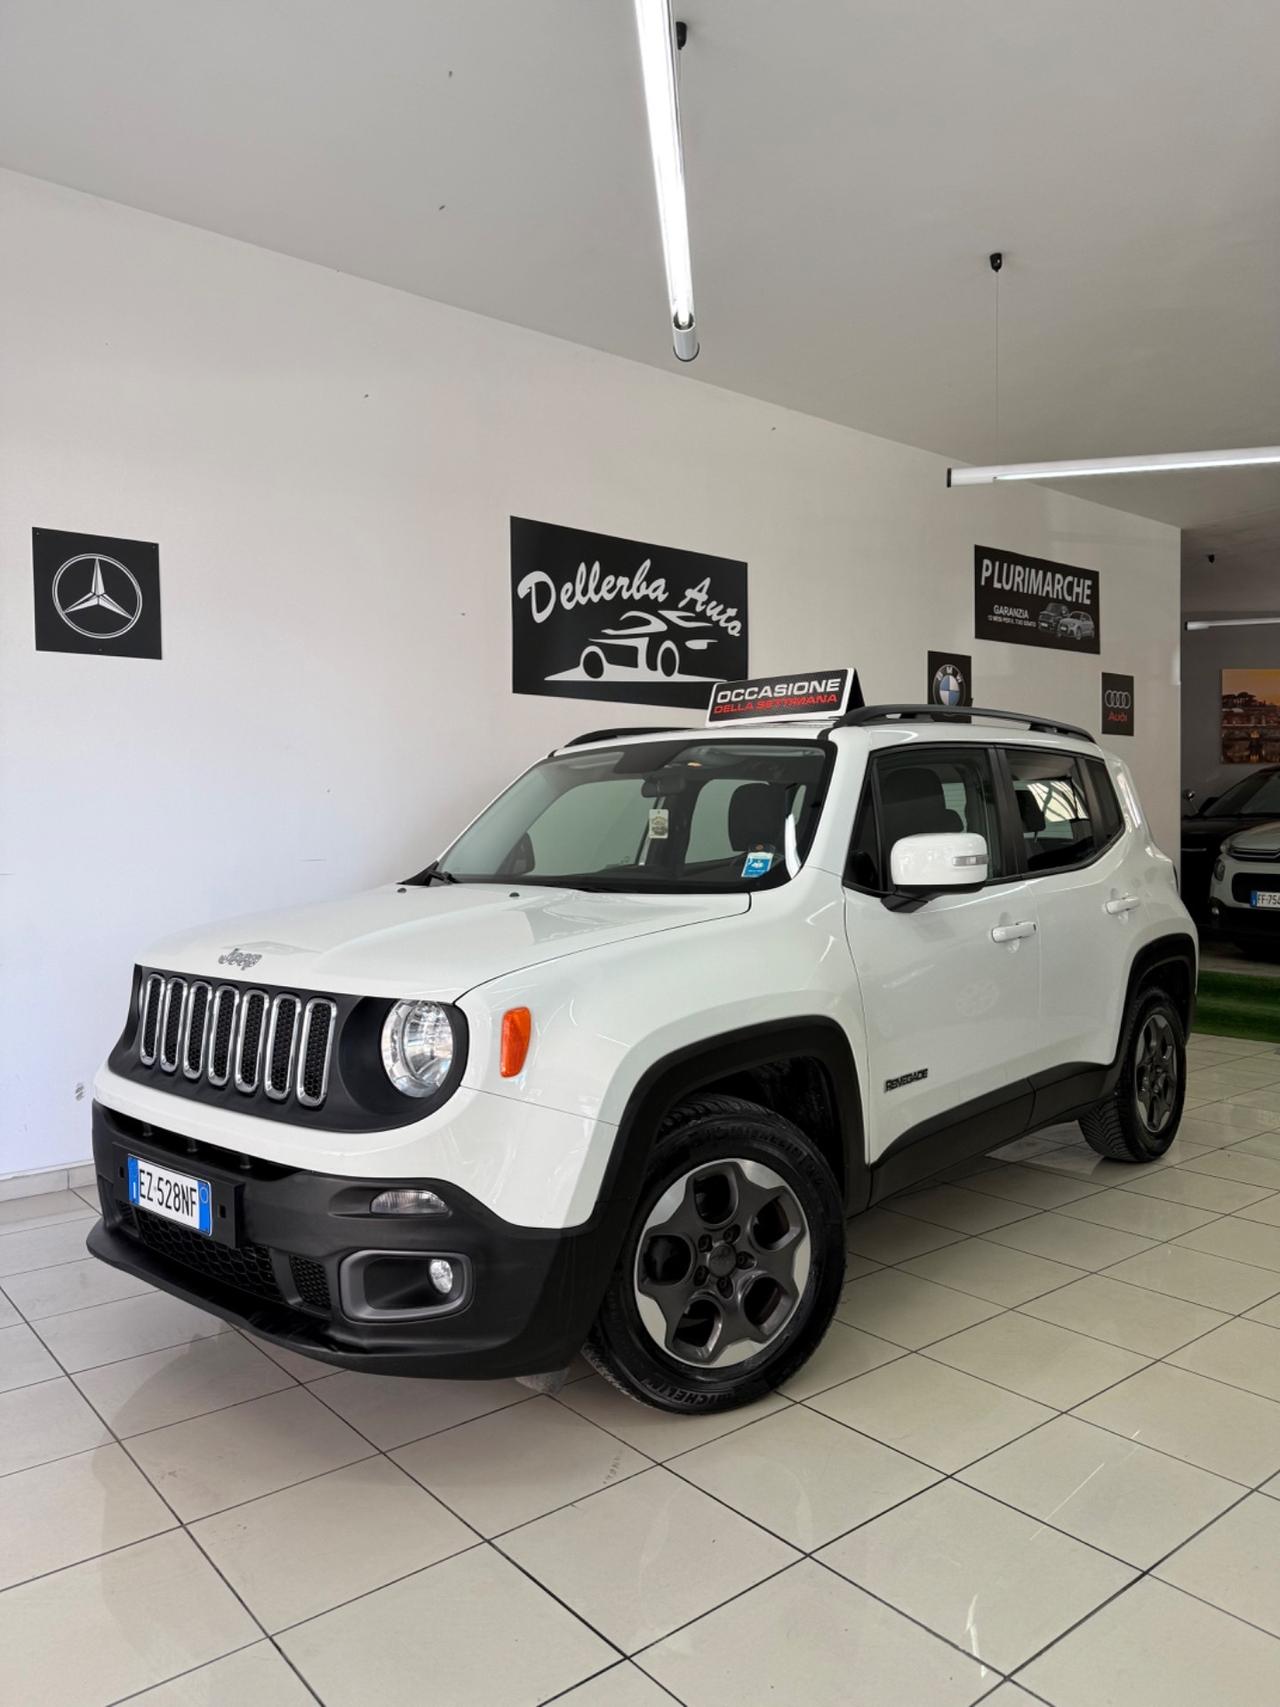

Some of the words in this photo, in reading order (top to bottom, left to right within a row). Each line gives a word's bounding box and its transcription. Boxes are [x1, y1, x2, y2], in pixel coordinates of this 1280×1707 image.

[980, 558, 1093, 605] PLURIMARCHE
[517, 558, 669, 623] Dellerba
[678, 577, 741, 637] Auto
[993, 604, 1030, 619] GARANZIA
[716, 678, 842, 703] OCCASIONE
[713, 701, 755, 714] DELLA
[756, 694, 838, 712] SETTIMANA
[218, 947, 262, 971] Jeep
